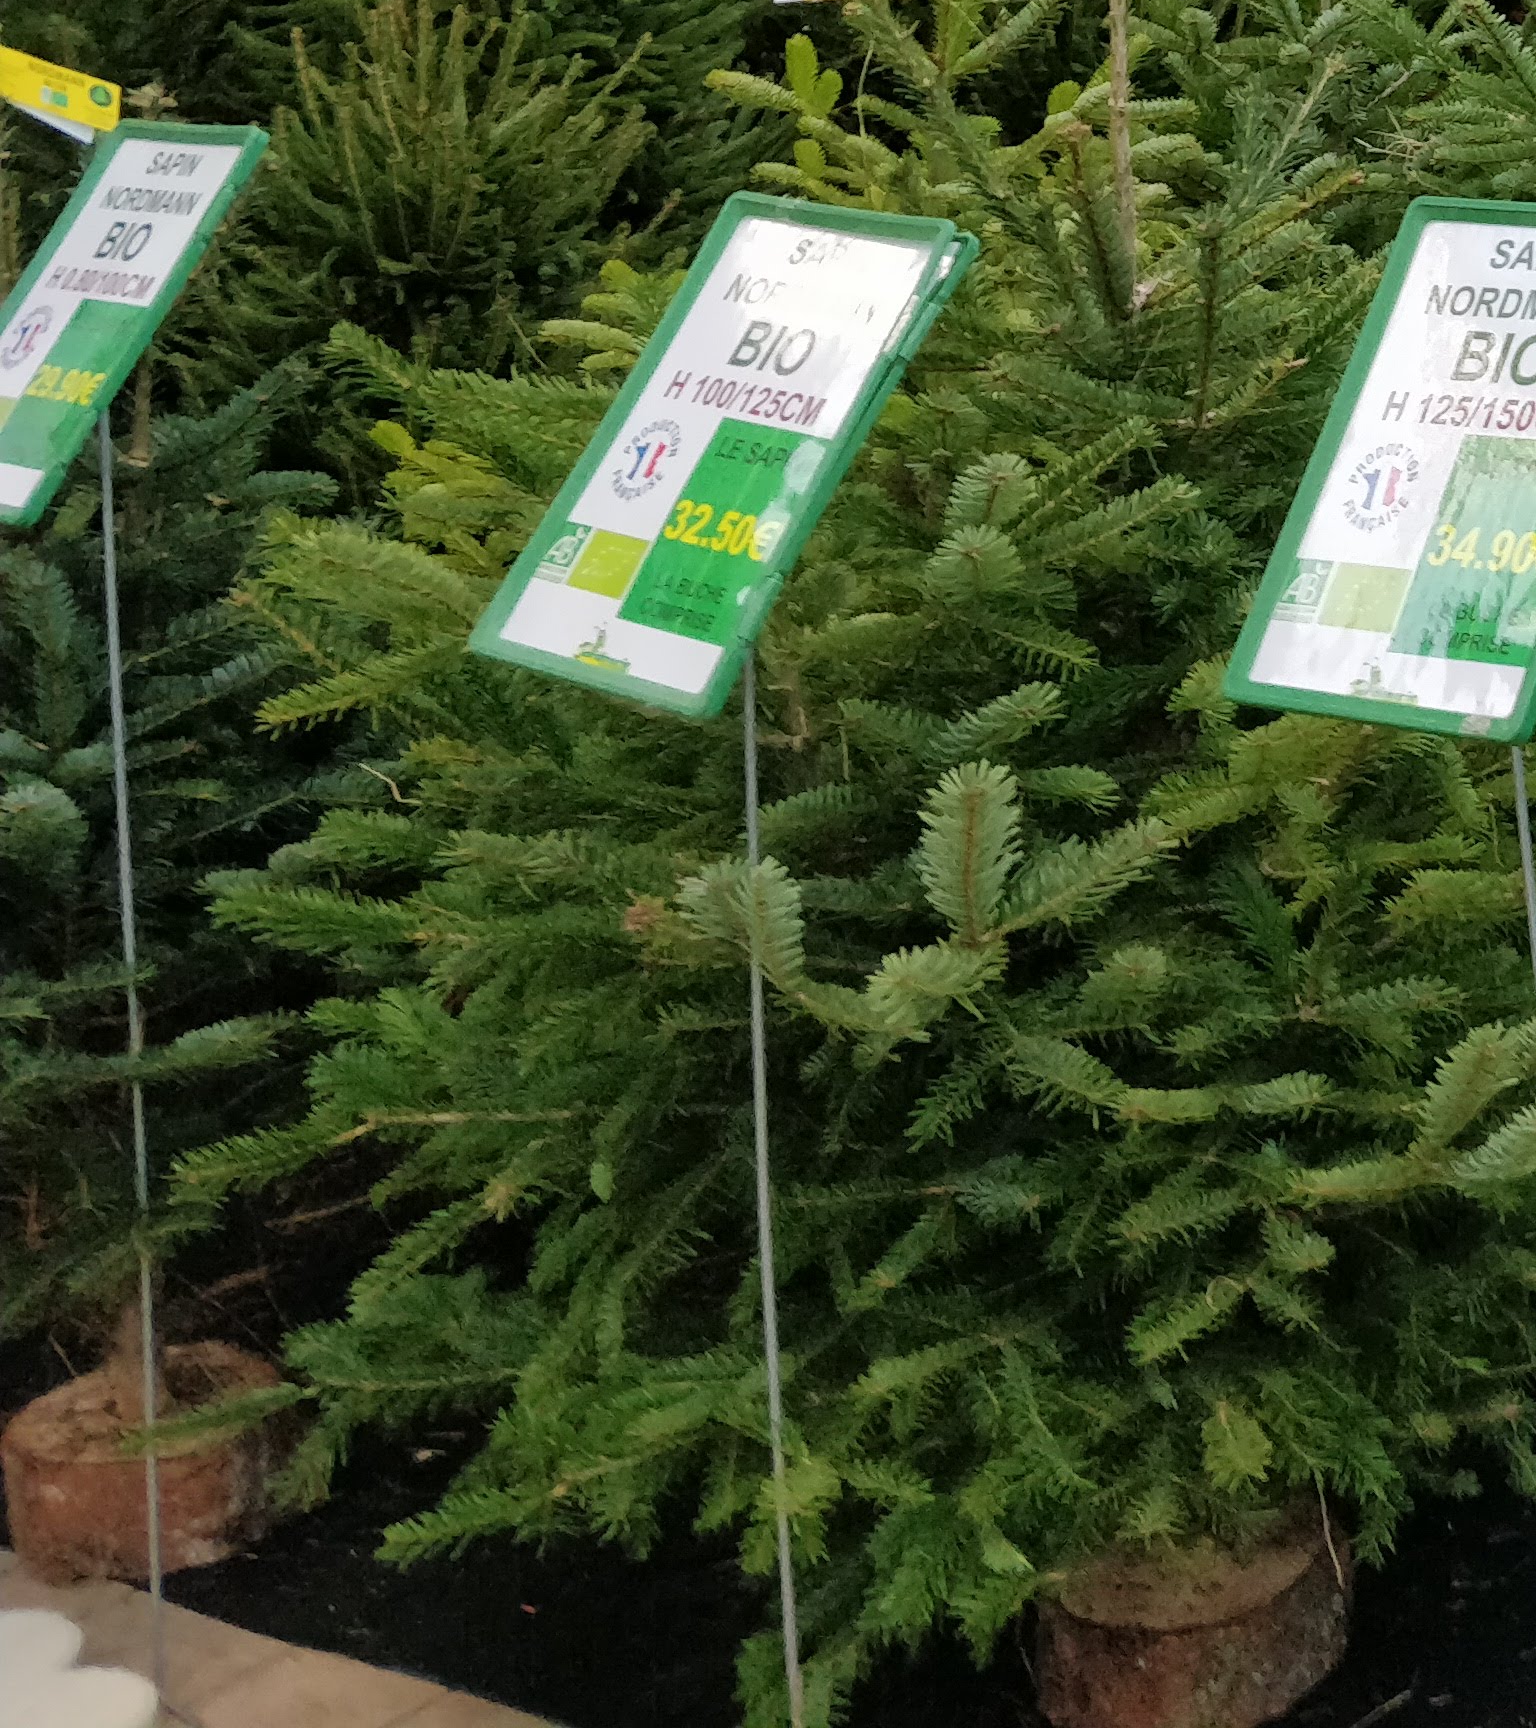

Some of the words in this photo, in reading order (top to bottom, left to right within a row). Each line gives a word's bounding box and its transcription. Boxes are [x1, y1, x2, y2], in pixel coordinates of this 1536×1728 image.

[146, 152, 204, 177] SAPIN
[100, 186, 203, 215] NORDMANN
[93, 222, 153, 261] BIO
[727, 321, 816, 376] BIO
[664, 369, 692, 400] H
[691, 375, 827, 426] 100/125CM
[1381, 390, 1410, 422] H
[714, 437, 745, 460] LE
[663, 499, 786, 561] 32.50€
